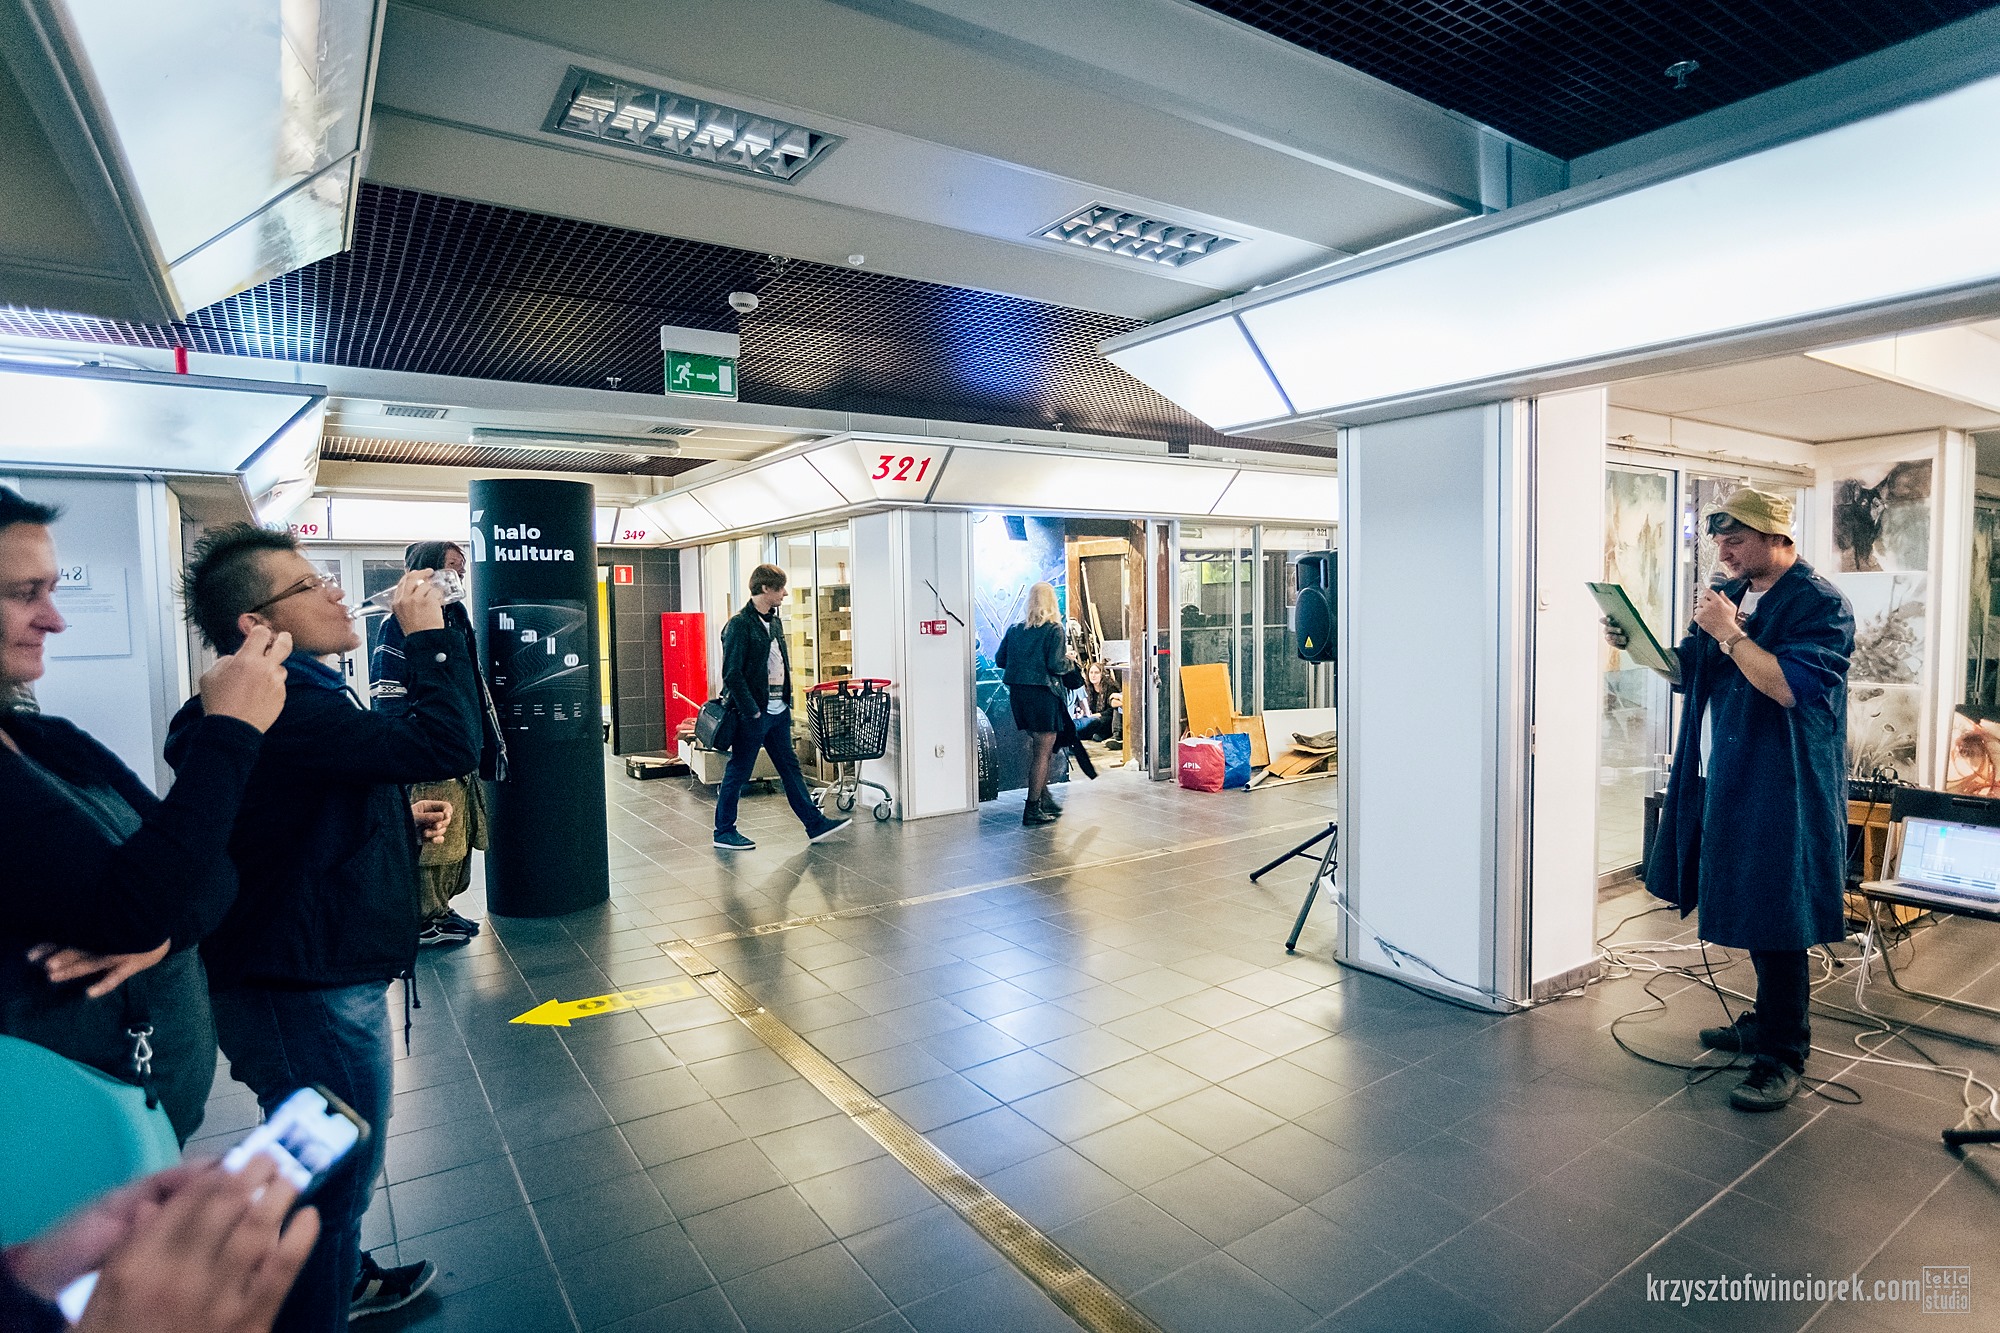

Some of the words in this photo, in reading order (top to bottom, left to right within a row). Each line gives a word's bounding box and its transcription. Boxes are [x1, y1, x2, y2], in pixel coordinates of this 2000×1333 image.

[872, 455, 931, 482] 321
[493, 523, 541, 540] halo
[622, 529, 646, 540] 349
[494, 545, 575, 562] kultura
